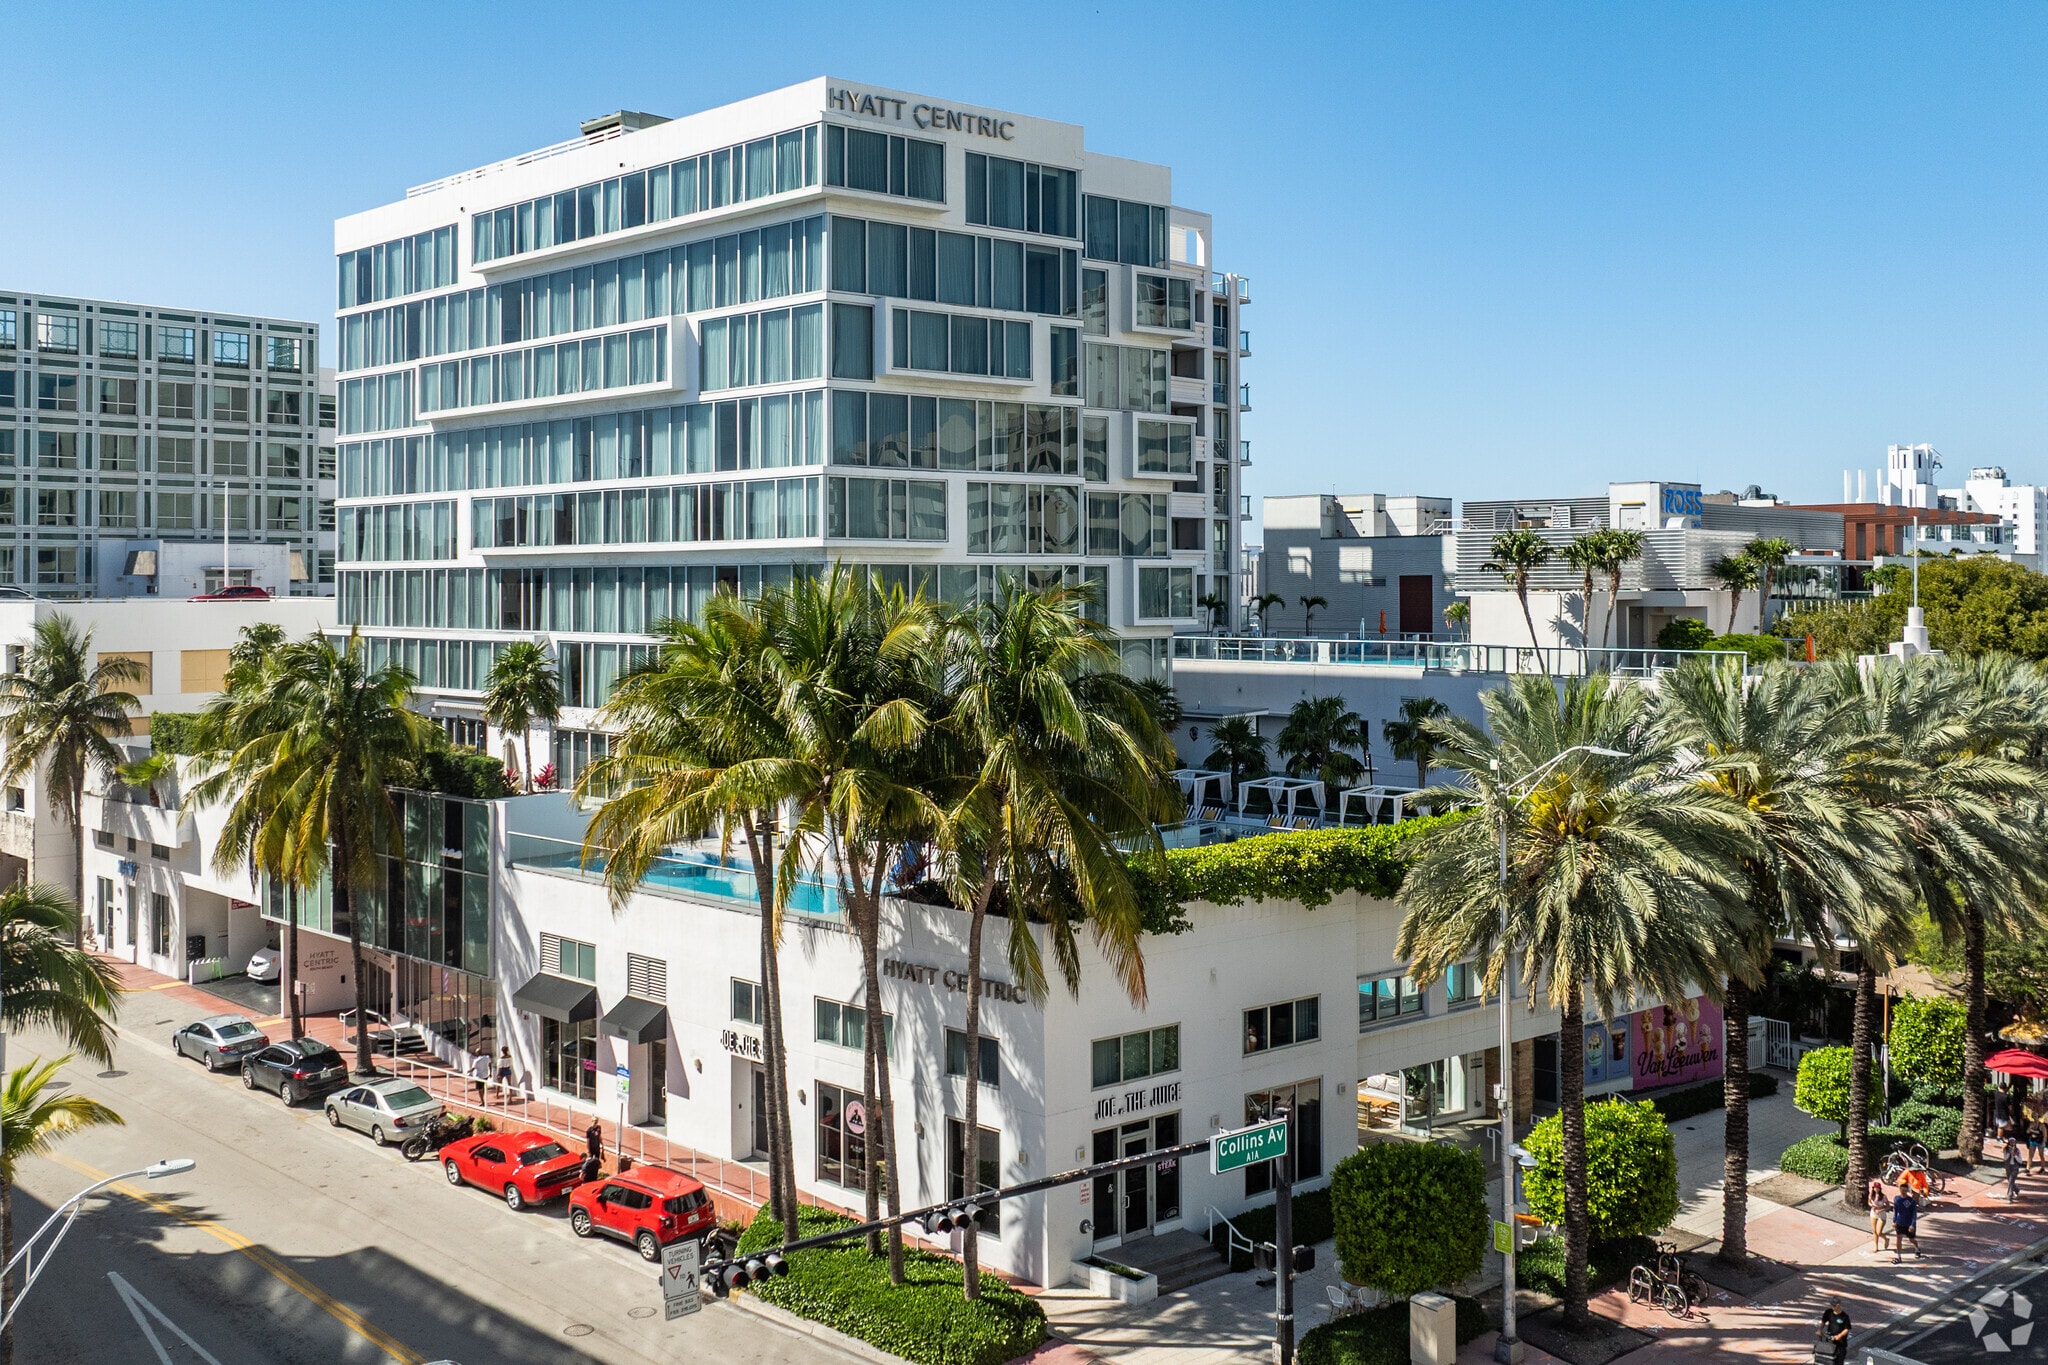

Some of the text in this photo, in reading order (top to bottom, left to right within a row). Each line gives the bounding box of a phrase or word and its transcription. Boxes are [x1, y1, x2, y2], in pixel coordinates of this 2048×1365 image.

[829, 87, 1015, 141] HYATT CENTRIC
[1664, 488, 1703, 515] ROSS
[303, 957, 339, 968] CENTRIC
[310, 950, 335, 959] HYATT
[883, 958, 1027, 1004] HYATT CETRIC
[1638, 1045, 1718, 1077] Van Leeuwen
[1095, 1097, 1116, 1120] JOE
[1125, 1090, 1146, 1112] THE
[1150, 1082, 1182, 1107] JUICE
[1220, 1128, 1284, 1157] Collins Av
[1246, 1150, 1259, 1162] A1A
[667, 1253, 694, 1265] VEHICLES
[668, 1246, 692, 1258] TURNING
